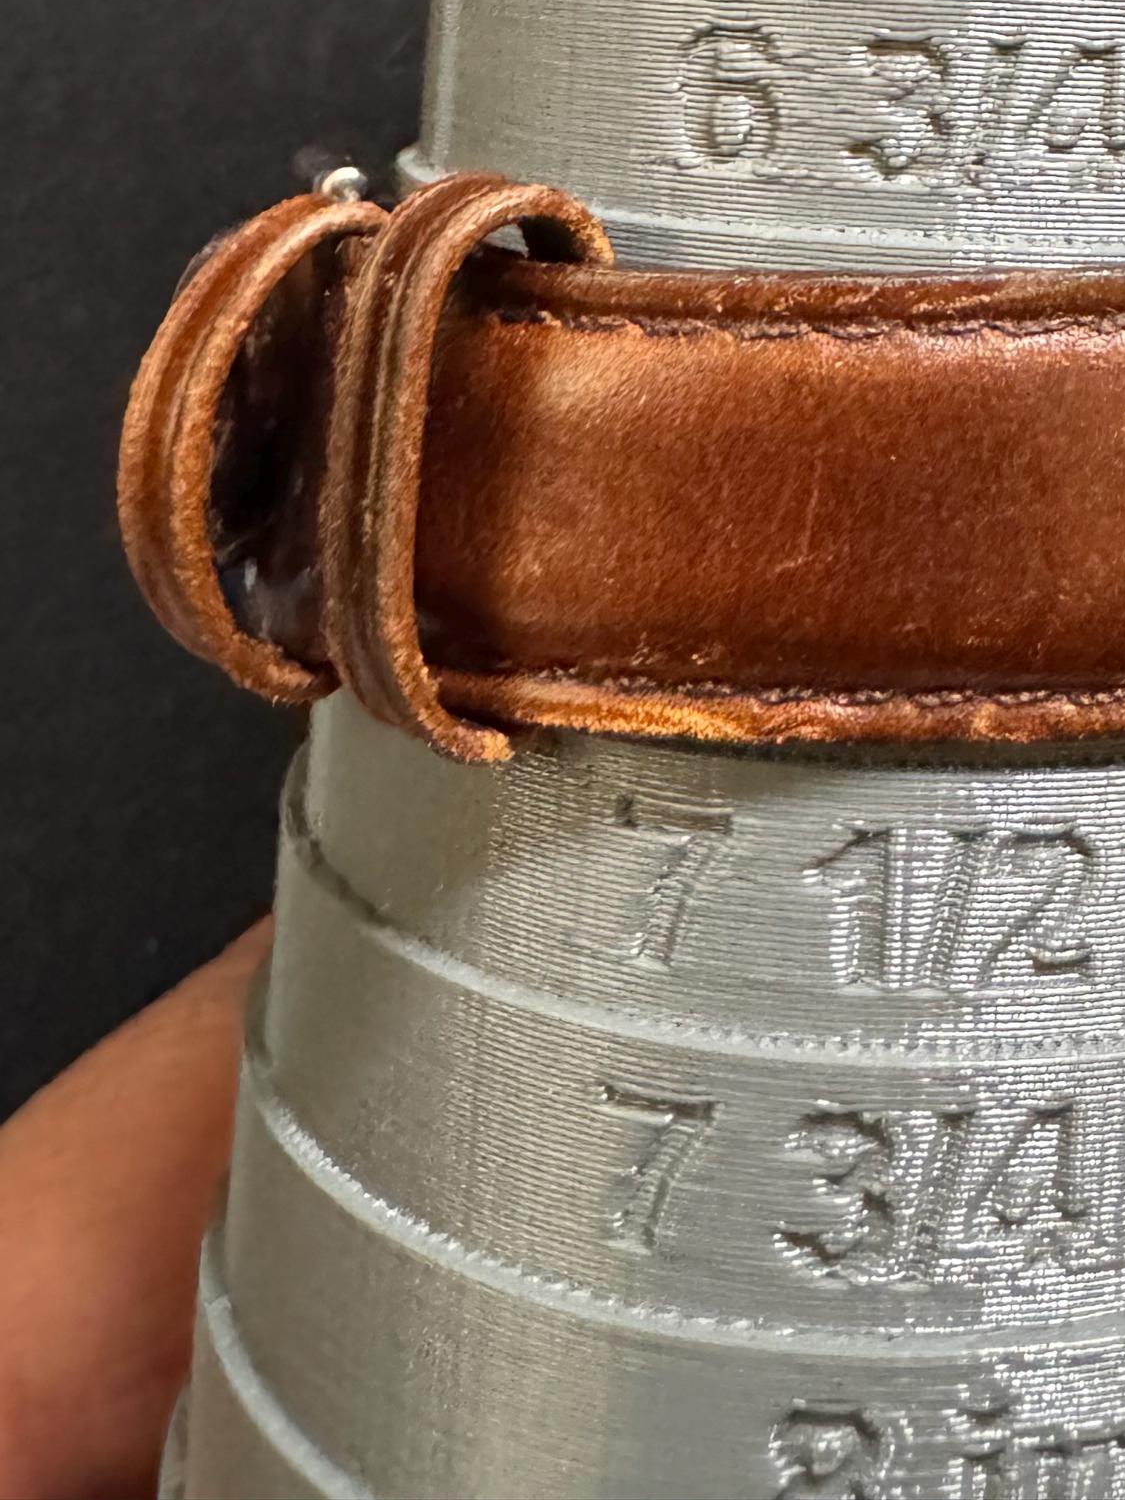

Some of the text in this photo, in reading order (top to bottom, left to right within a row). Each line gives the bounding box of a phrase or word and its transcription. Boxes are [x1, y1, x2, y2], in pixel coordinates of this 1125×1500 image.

[676, 22, 782, 170] 6
[614, 792, 734, 970] 7
[802, 820, 1096, 995] 1/2
[600, 1084, 720, 1252] 7
[772, 1100, 1085, 1290] 3/4
